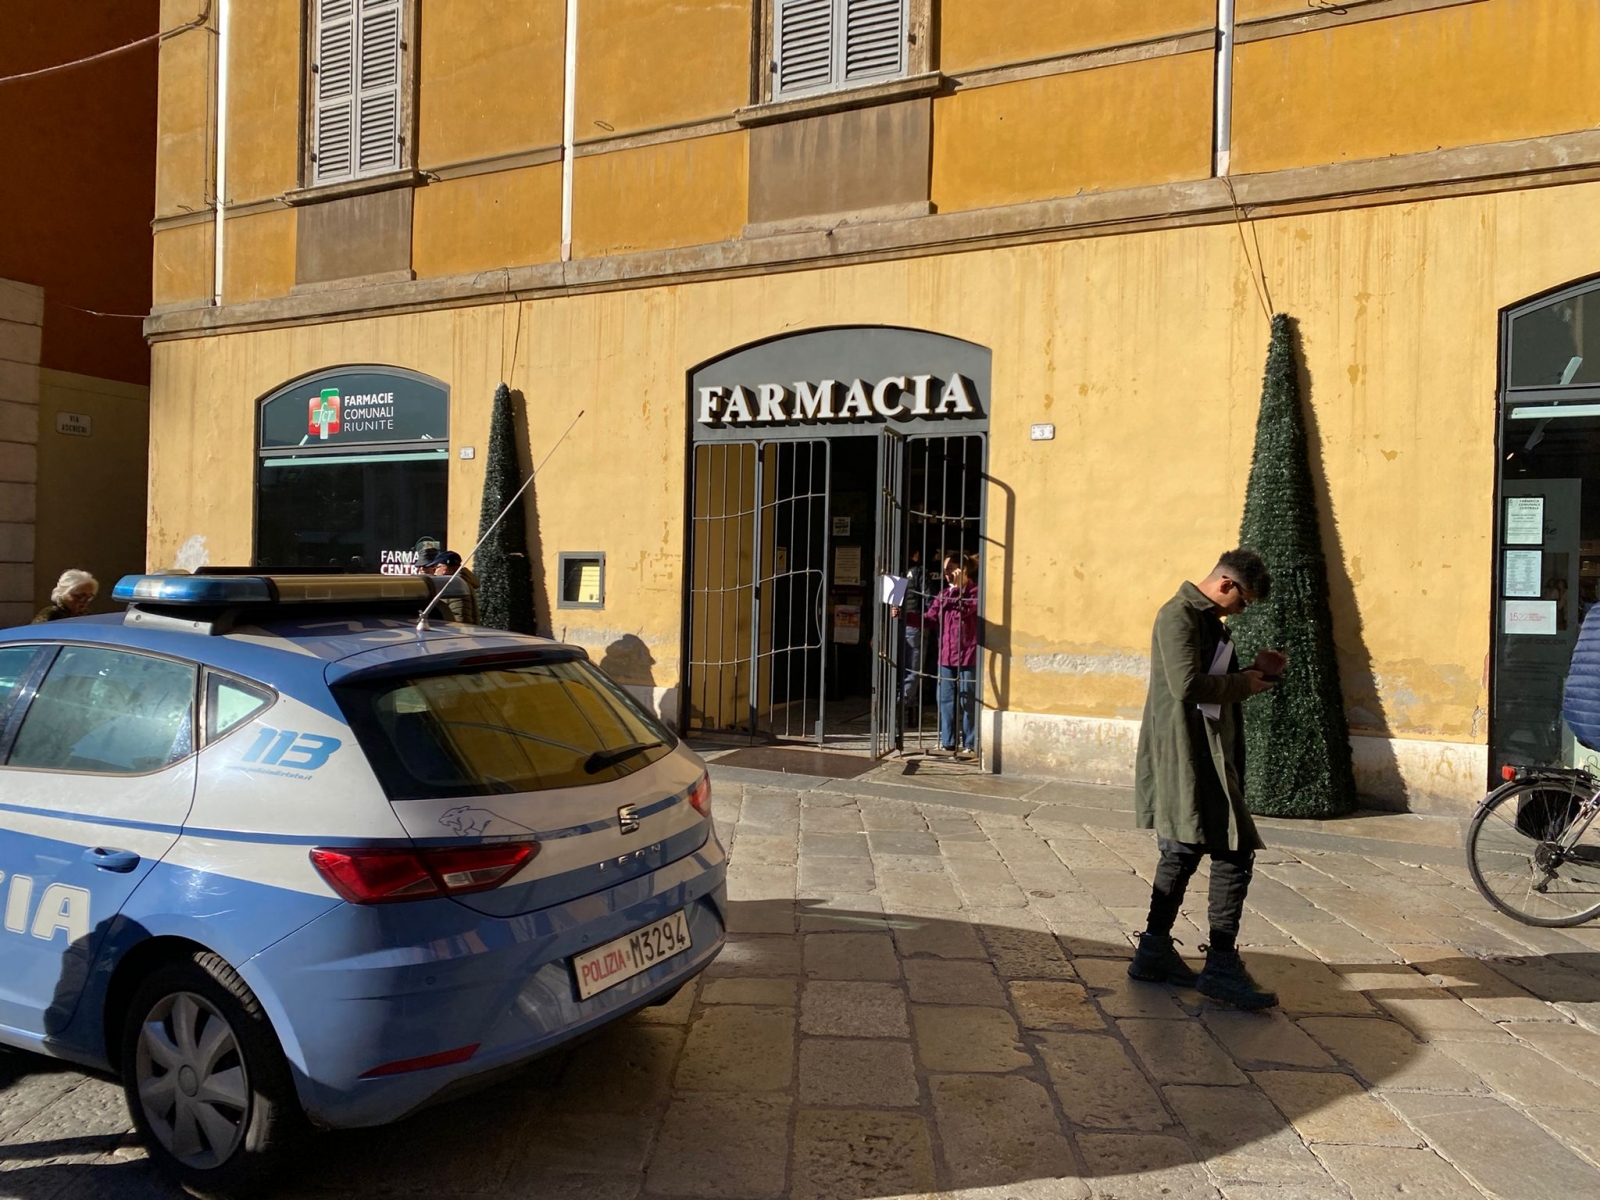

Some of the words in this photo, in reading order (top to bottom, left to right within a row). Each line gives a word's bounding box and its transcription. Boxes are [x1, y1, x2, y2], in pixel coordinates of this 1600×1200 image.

[344, 392, 394, 407] FARMACIE
[697, 372, 976, 423] FARMACIA
[344, 406, 394, 420] COMUNALI
[344, 419, 394, 432] RIUNITE
[380, 563, 421, 576] CENTR
[1509, 612, 1529, 622] 1522
[241, 727, 342, 770] 113
[599, 842, 661, 873] LEON
[0, 870, 91, 951] IA
[581, 949, 627, 987] POLIZIA
[629, 915, 686, 969] M3294
